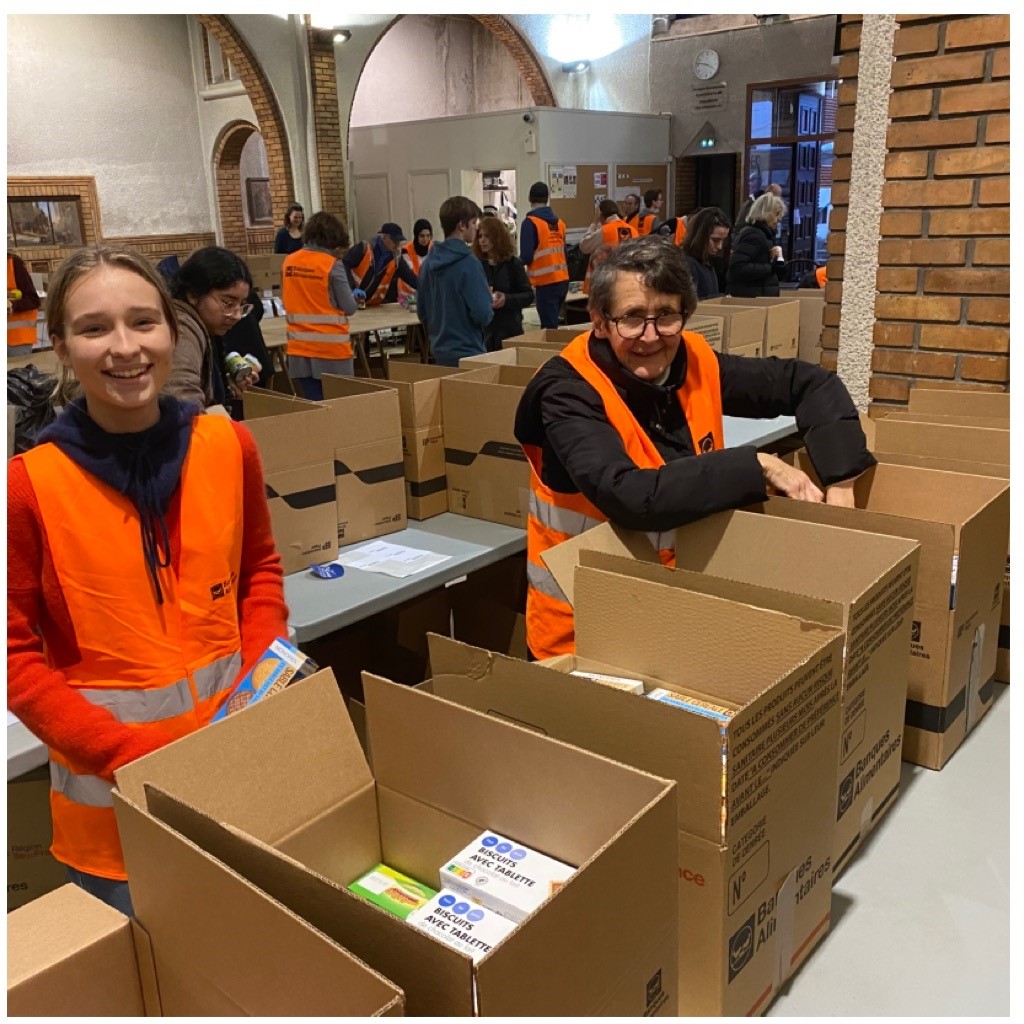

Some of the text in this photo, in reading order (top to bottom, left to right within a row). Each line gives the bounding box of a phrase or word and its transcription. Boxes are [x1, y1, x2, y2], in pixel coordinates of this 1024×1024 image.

[856, 728, 890, 779] Banques
[469, 854, 495, 868] AVEC
[494, 864, 537, 888] TABLETTE
[477, 846, 518, 869] BISCUITS
[424, 915, 493, 953] AVEC TABLETTE
[433, 906, 474, 931] BISCUITS
